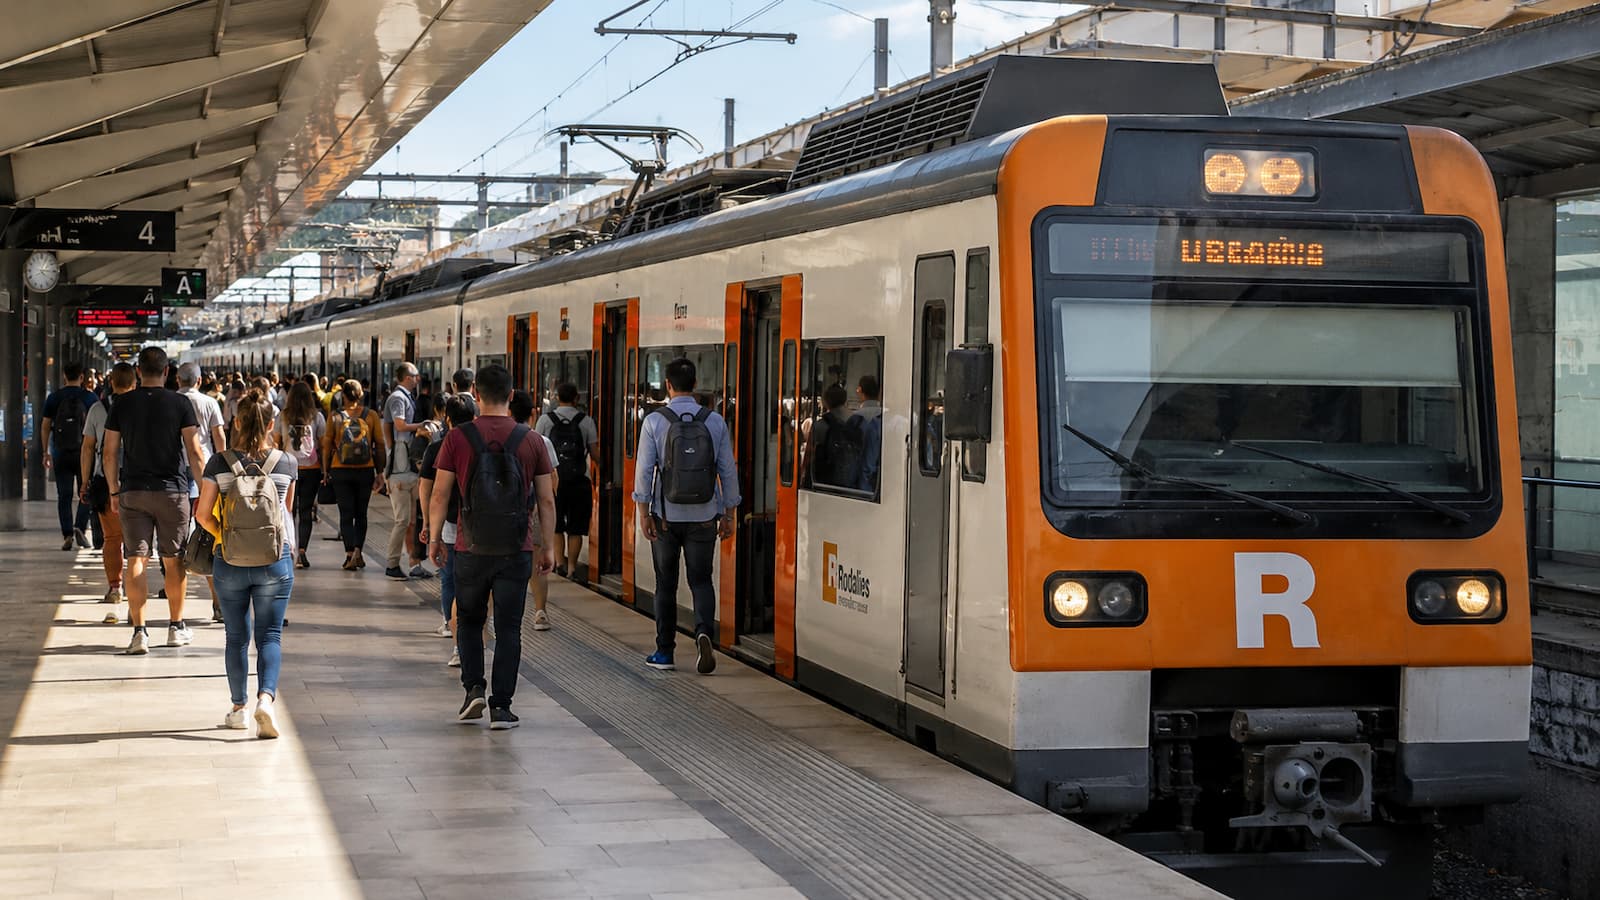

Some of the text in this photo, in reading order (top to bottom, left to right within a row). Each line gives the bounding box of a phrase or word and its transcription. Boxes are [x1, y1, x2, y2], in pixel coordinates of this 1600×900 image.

[138, 220, 156, 245] 4
[176, 275, 192, 295] A
[838, 564, 870, 598] Rodalies
[1234, 552, 1320, 648] R
